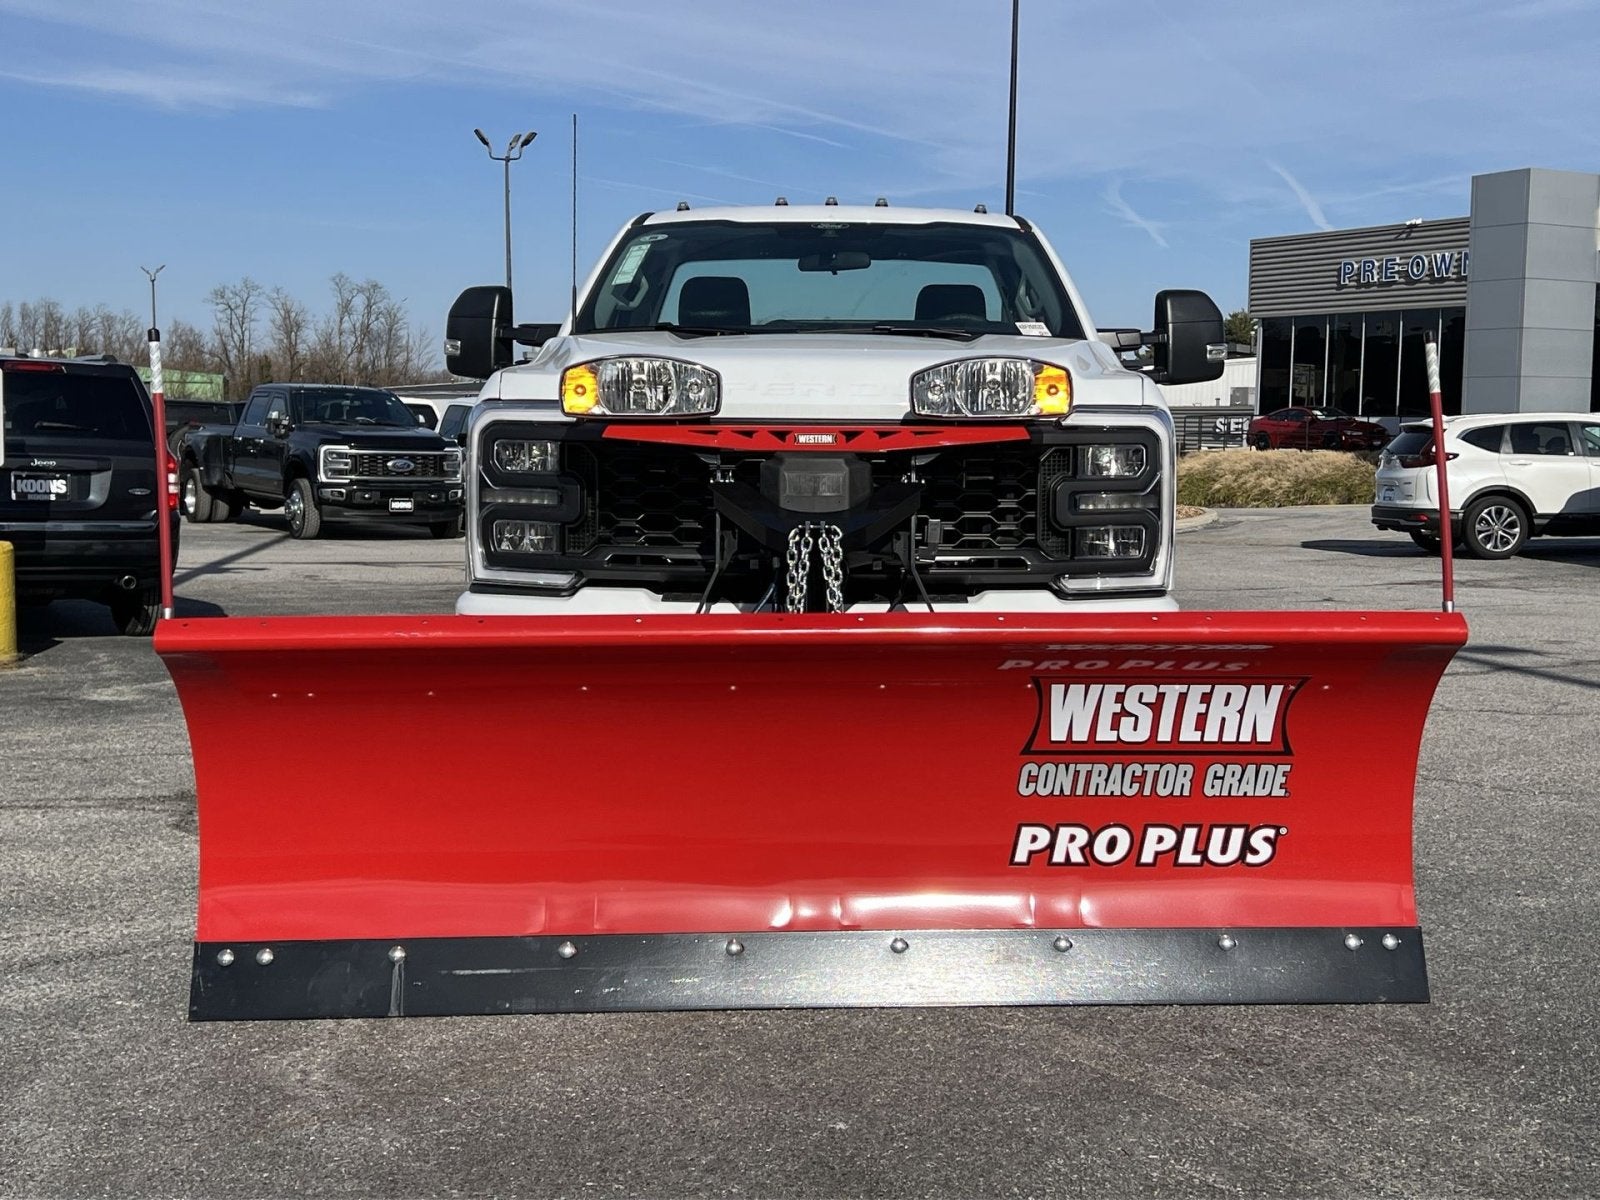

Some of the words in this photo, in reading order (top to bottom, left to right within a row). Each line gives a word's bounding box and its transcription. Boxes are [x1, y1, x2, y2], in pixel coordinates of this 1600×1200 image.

[798, 434, 833, 444] WESTERN
[16, 479, 67, 494] KOONS
[1050, 683, 1285, 743] WESTERN
[1018, 762, 1195, 798] CONTRACTOR
[1203, 763, 1291, 797] GRADE
[1011, 825, 1134, 866] PRO
[1137, 825, 1279, 866] PLUS
